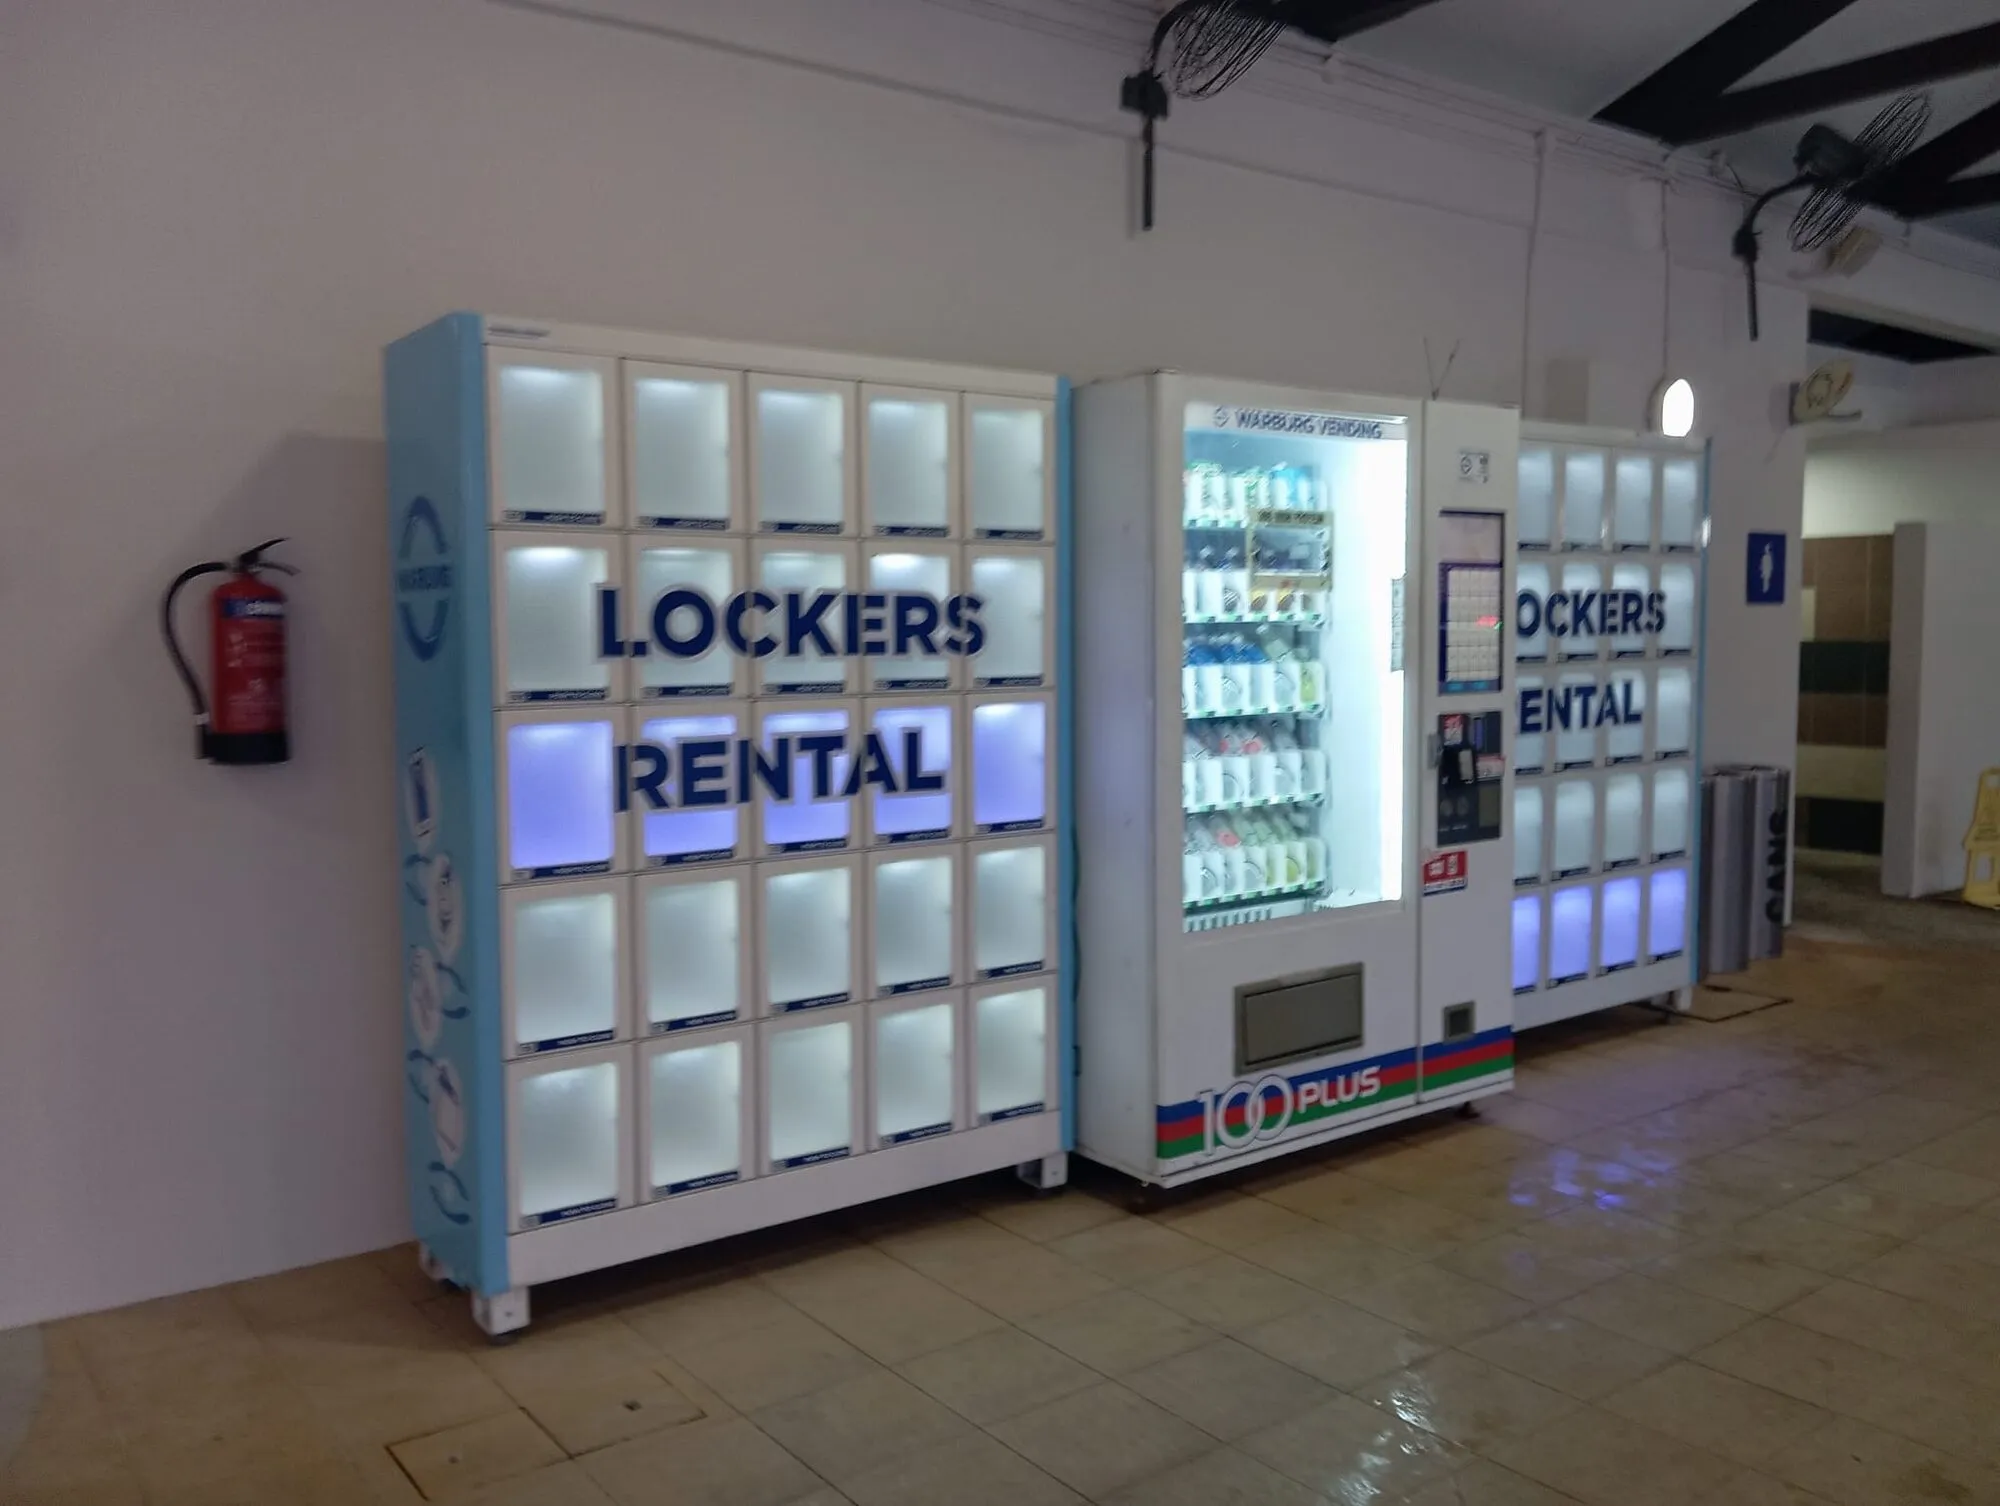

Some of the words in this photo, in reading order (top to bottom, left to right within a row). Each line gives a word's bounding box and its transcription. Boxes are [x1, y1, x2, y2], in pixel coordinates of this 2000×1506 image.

[1236, 409, 1315, 435] WARBURG
[1319, 416, 1383, 438] VENDING
[598, 587, 985, 659] LOCKERS
[1517, 591, 1665, 637] OCKERS
[1520, 681, 1642, 734] ENTAL
[614, 727, 945, 813] RENTAL
[1198, 1074, 1294, 1156] 100
[1299, 1065, 1382, 1113] PLUS
